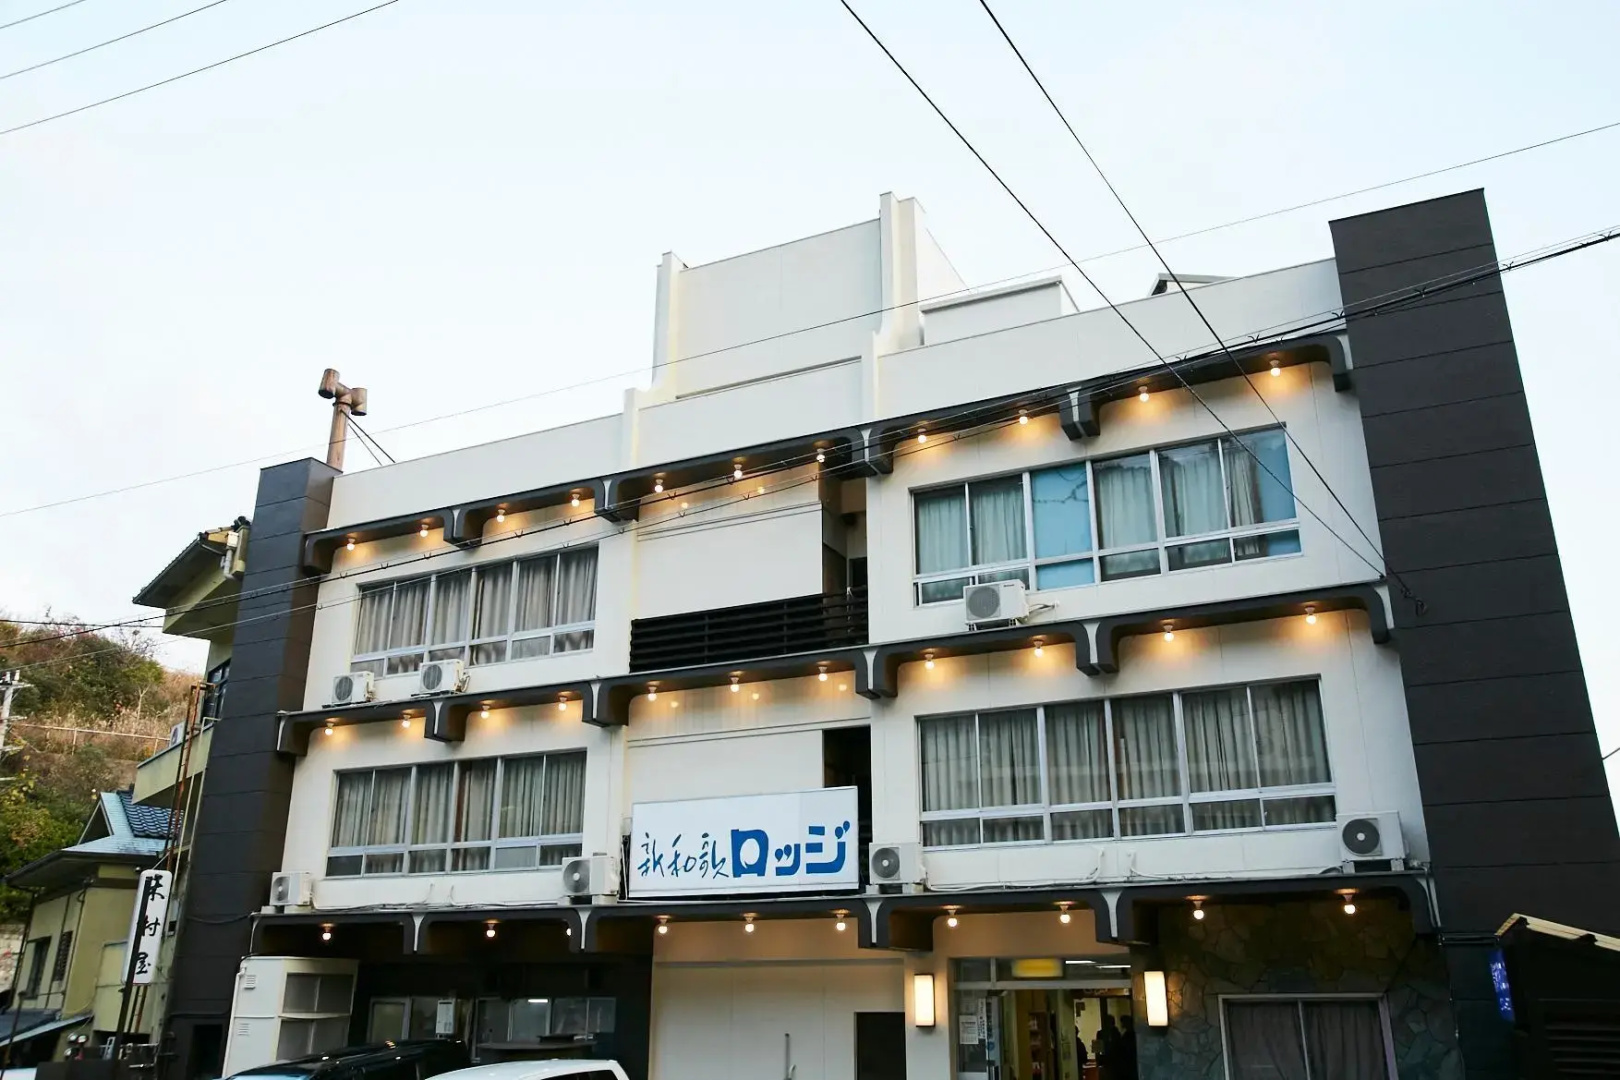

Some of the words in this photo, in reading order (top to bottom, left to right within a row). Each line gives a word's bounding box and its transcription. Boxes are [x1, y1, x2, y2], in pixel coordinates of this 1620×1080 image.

[637, 820, 851, 880] 新和歌ロッジ
